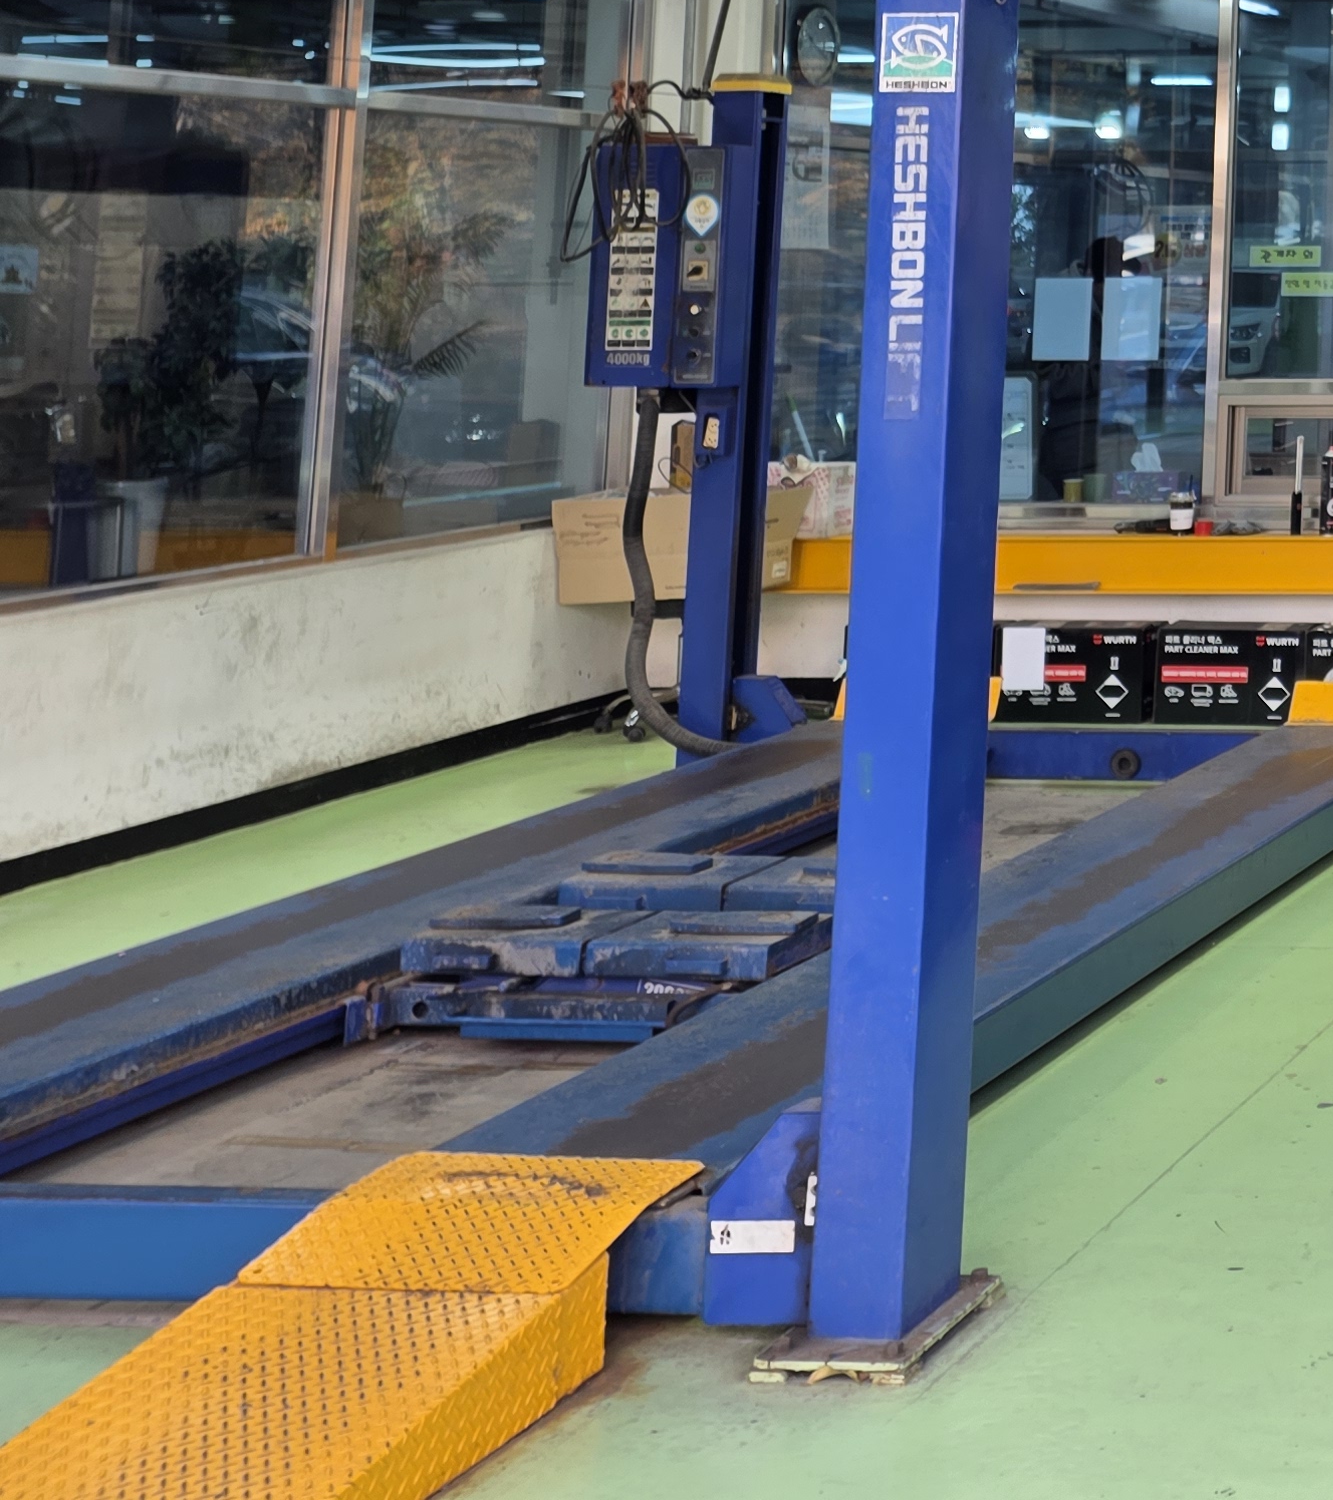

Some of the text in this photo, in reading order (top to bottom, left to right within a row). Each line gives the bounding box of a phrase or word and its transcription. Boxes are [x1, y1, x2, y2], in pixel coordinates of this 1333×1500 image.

[886, 81, 948, 89] HESHBON
[891, 106, 929, 308] HESHBON
[607, 353, 650, 366] 4000kg
[1164, 645, 1239, 655] PART CLEANER MAX
[1312, 649, 1331, 657] PART
